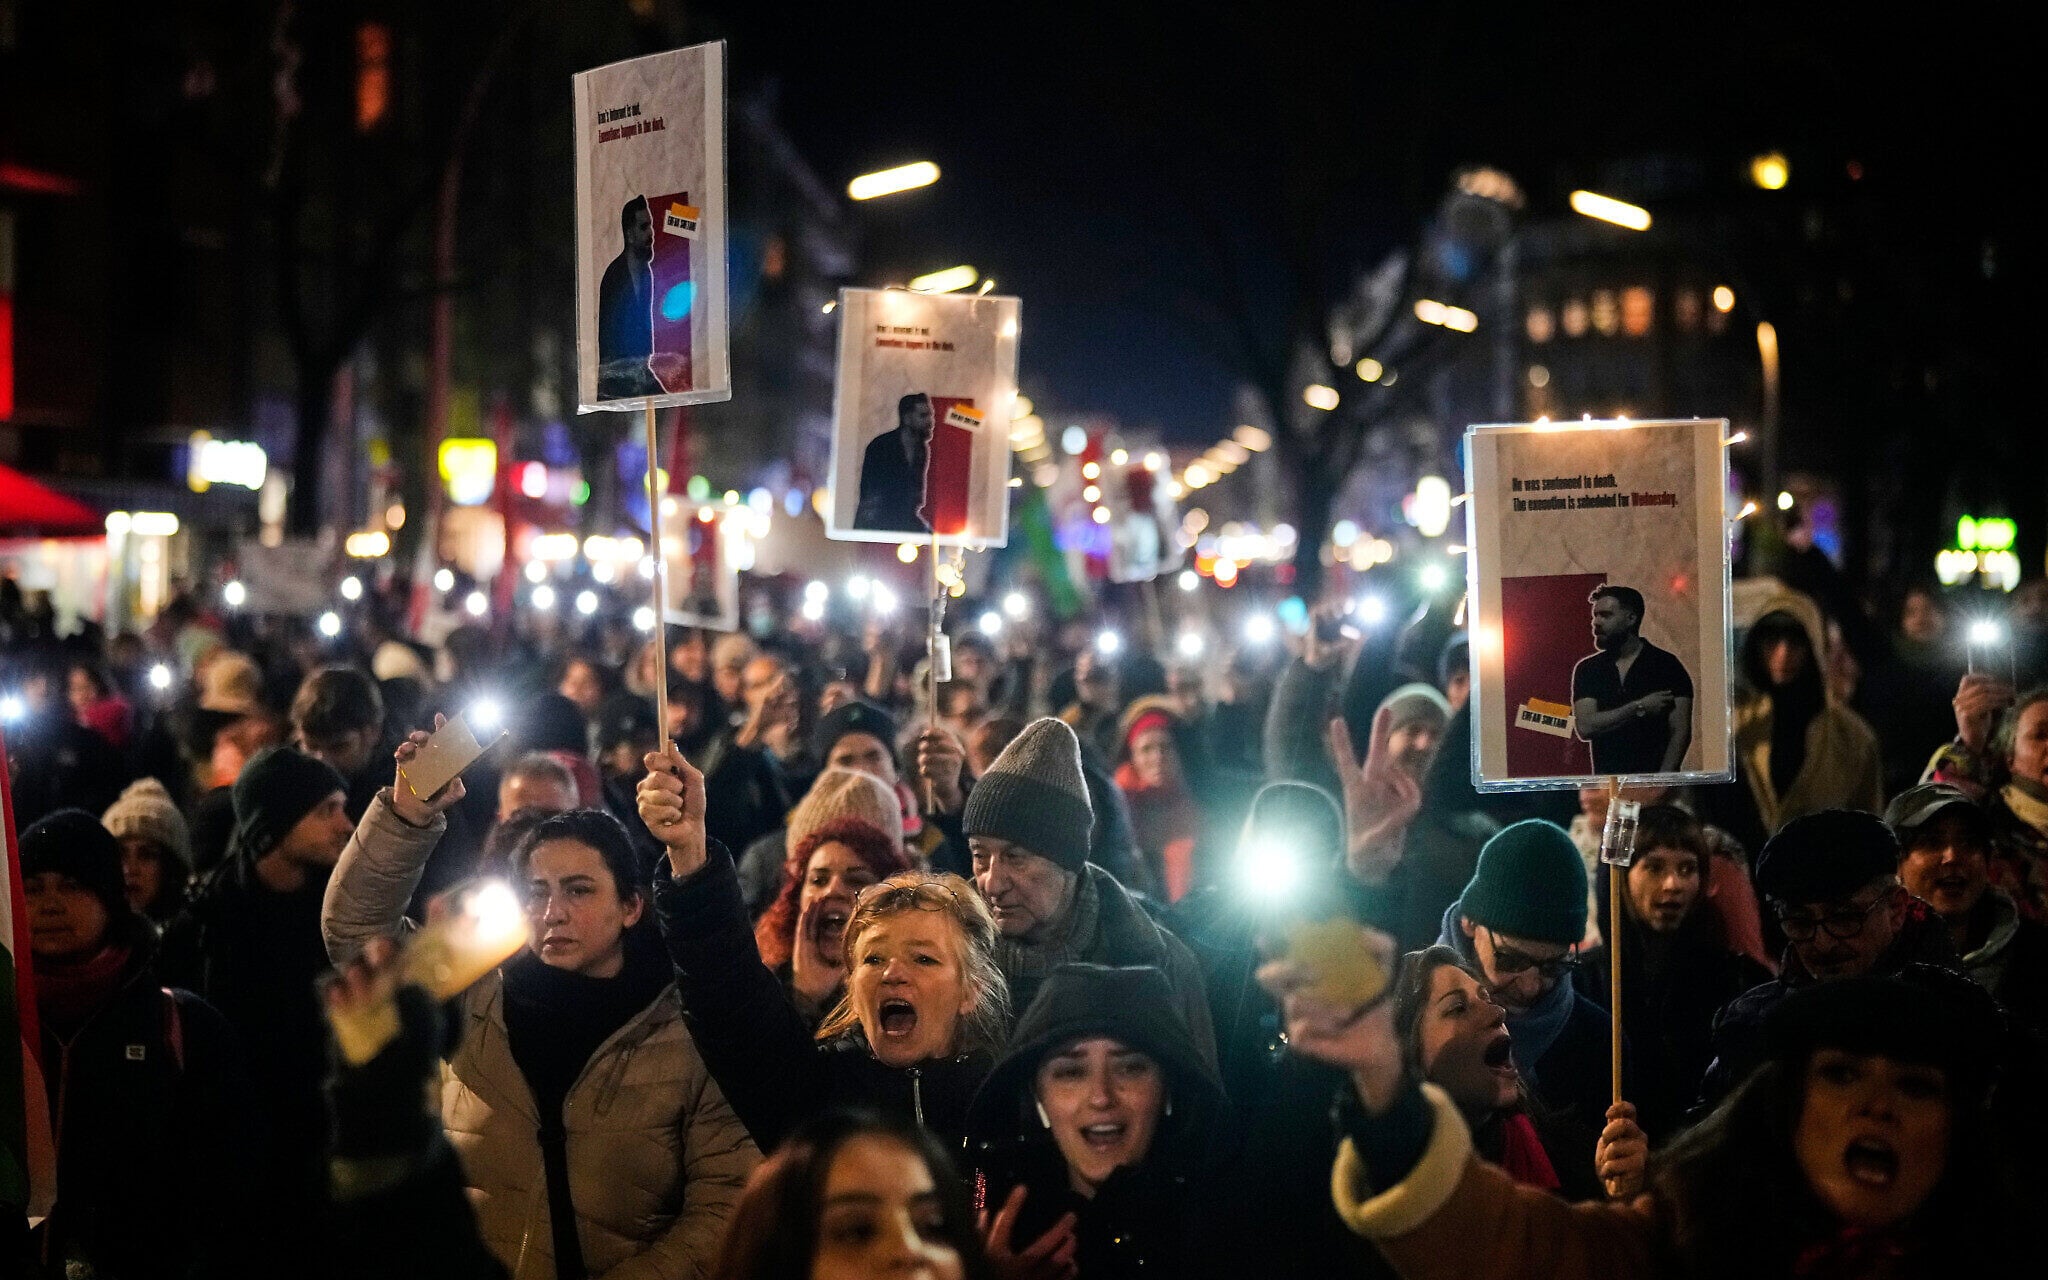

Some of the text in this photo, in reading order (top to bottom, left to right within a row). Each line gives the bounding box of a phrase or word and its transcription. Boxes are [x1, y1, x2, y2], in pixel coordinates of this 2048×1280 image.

[637, 121, 643, 135] in
[643, 119, 651, 133] the
[1512, 473, 1617, 491] He was sentenced to death.
[1513, 490, 1679, 511] The execution is scheduled for Wednesday.
[1522, 711, 1568, 729] ERFAN SOLTANI
